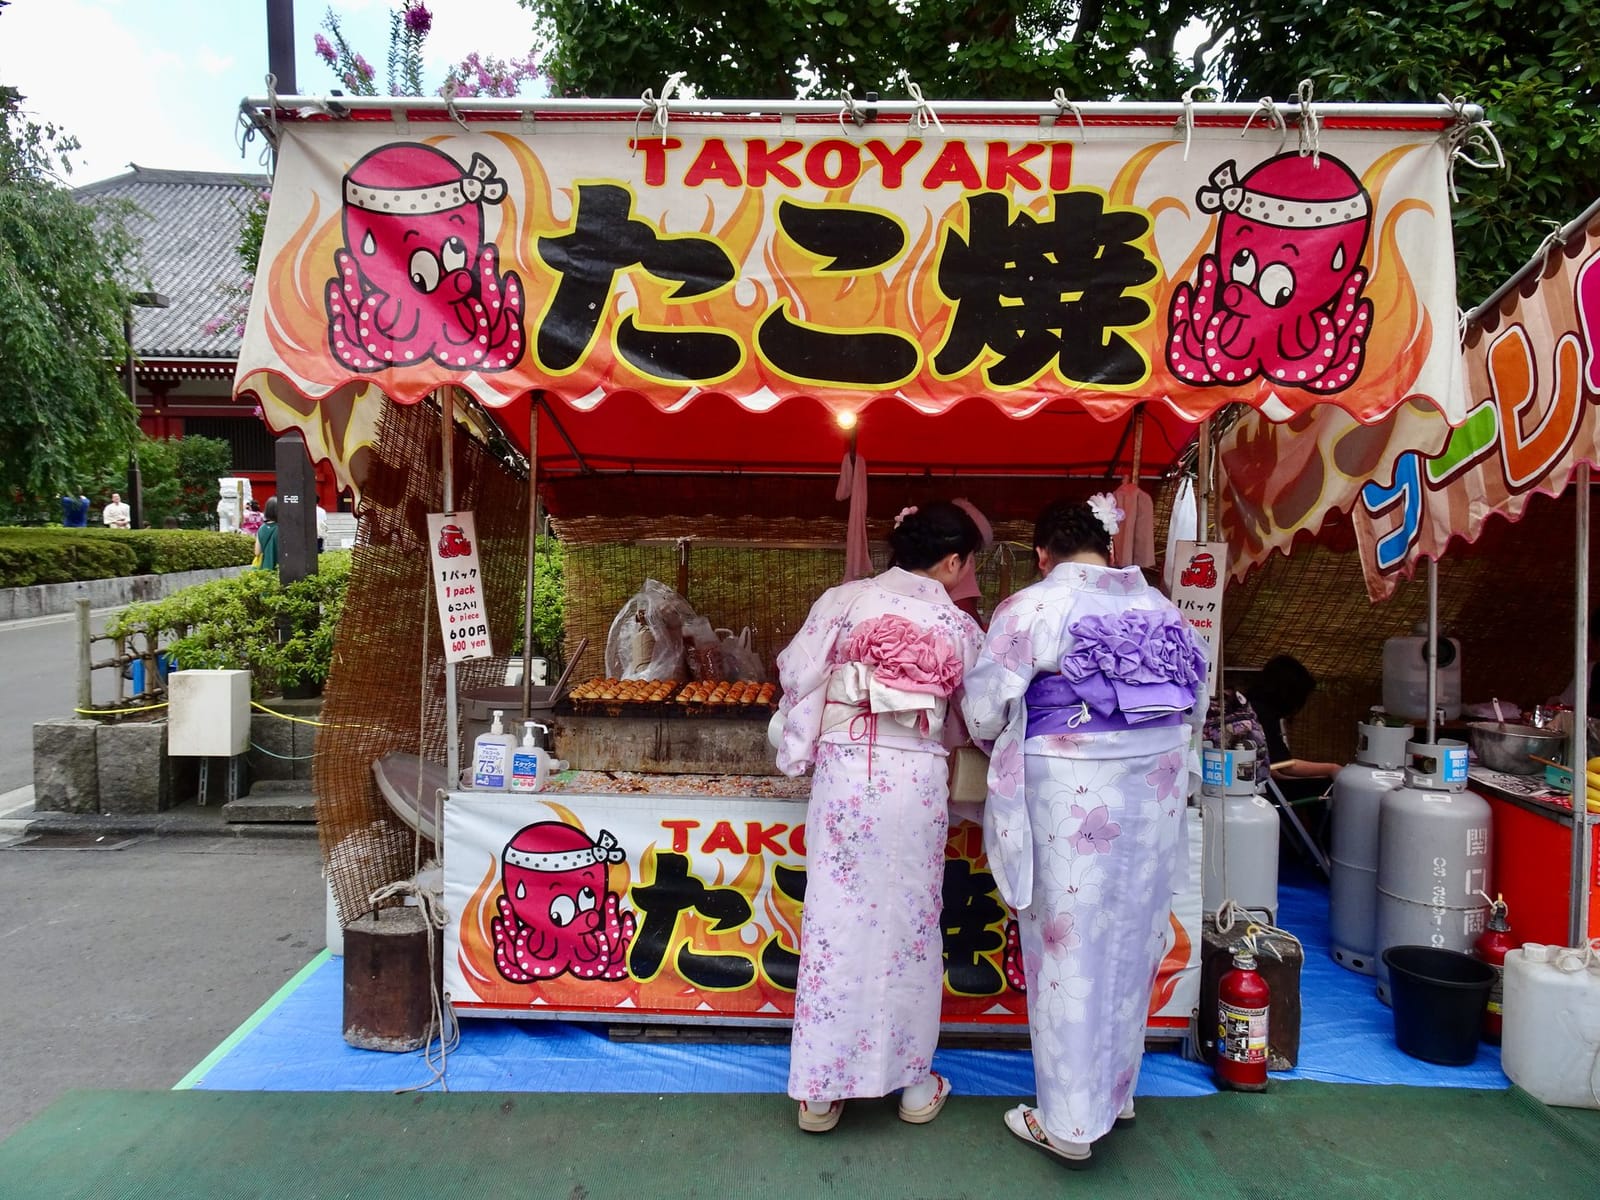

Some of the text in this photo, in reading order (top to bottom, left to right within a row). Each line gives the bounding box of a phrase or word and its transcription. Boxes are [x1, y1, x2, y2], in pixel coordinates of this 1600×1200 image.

[629, 138, 1075, 192] TAKOYAKI
[535, 184, 1160, 389] たこ焼
[446, 585, 475, 598] 1 pack
[448, 601, 477, 612] 6こ入り
[450, 613, 479, 623] 6 piece
[450, 624, 487, 640] 600円
[453, 639, 486, 652] 600 yen
